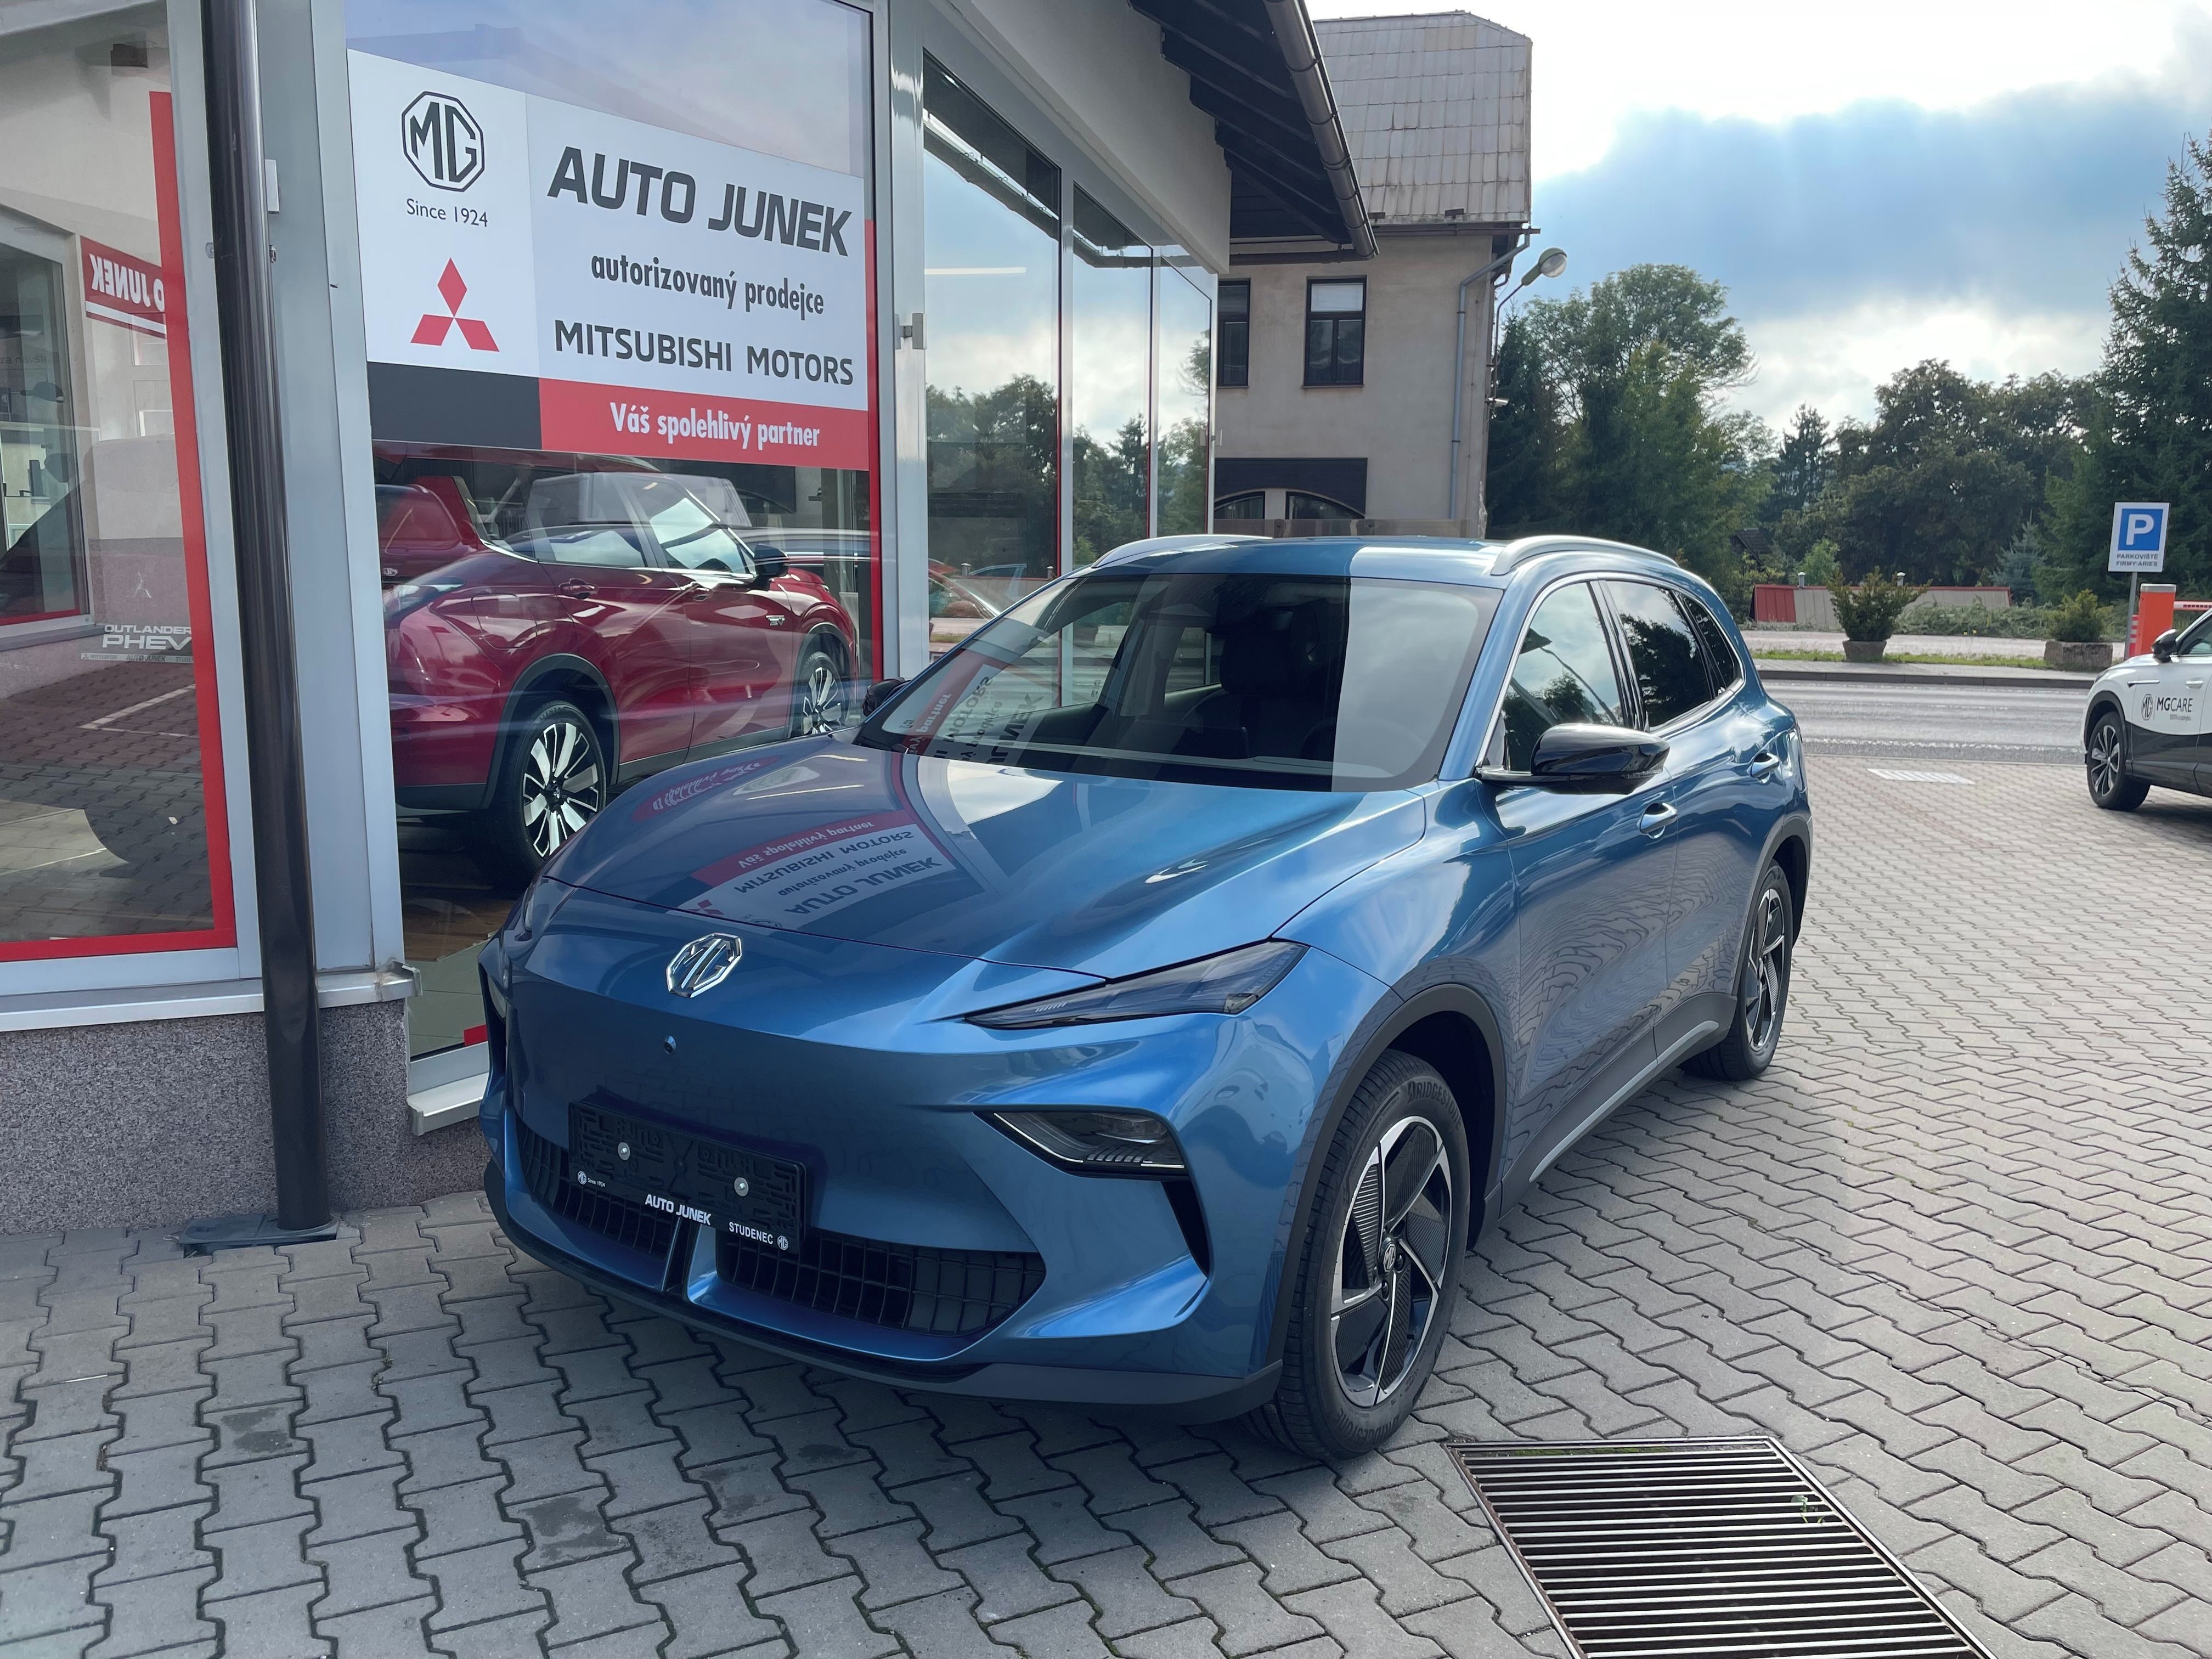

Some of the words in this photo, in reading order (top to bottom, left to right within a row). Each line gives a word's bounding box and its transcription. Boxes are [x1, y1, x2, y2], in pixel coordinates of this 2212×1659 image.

[407, 97, 480, 187] MG
[407, 198, 446, 221] Since
[454, 206, 488, 228] 1924
[547, 146, 696, 224] AUTO
[708, 183, 853, 257] JUNEK
[591, 254, 737, 309] autorizovaný
[745, 279, 824, 320] prodejce
[555, 319, 731, 372] MITSUBISHI
[747, 346, 854, 386] MOTORS
[610, 402, 650, 435] Váš
[657, 409, 751, 450] spolehlivý
[758, 421, 821, 450] partner
[2126, 514, 2154, 545] P
[102, 634, 192, 651] PHEV
[104, 624, 191, 635] OUTLANDER
[2142, 695, 2153, 720] MG
[645, 1194, 674, 1213] AUTO
[676, 1204, 712, 1225] JUNEK
[729, 1221, 773, 1244] STUDENEC
[777, 1235, 788, 1250] MG
